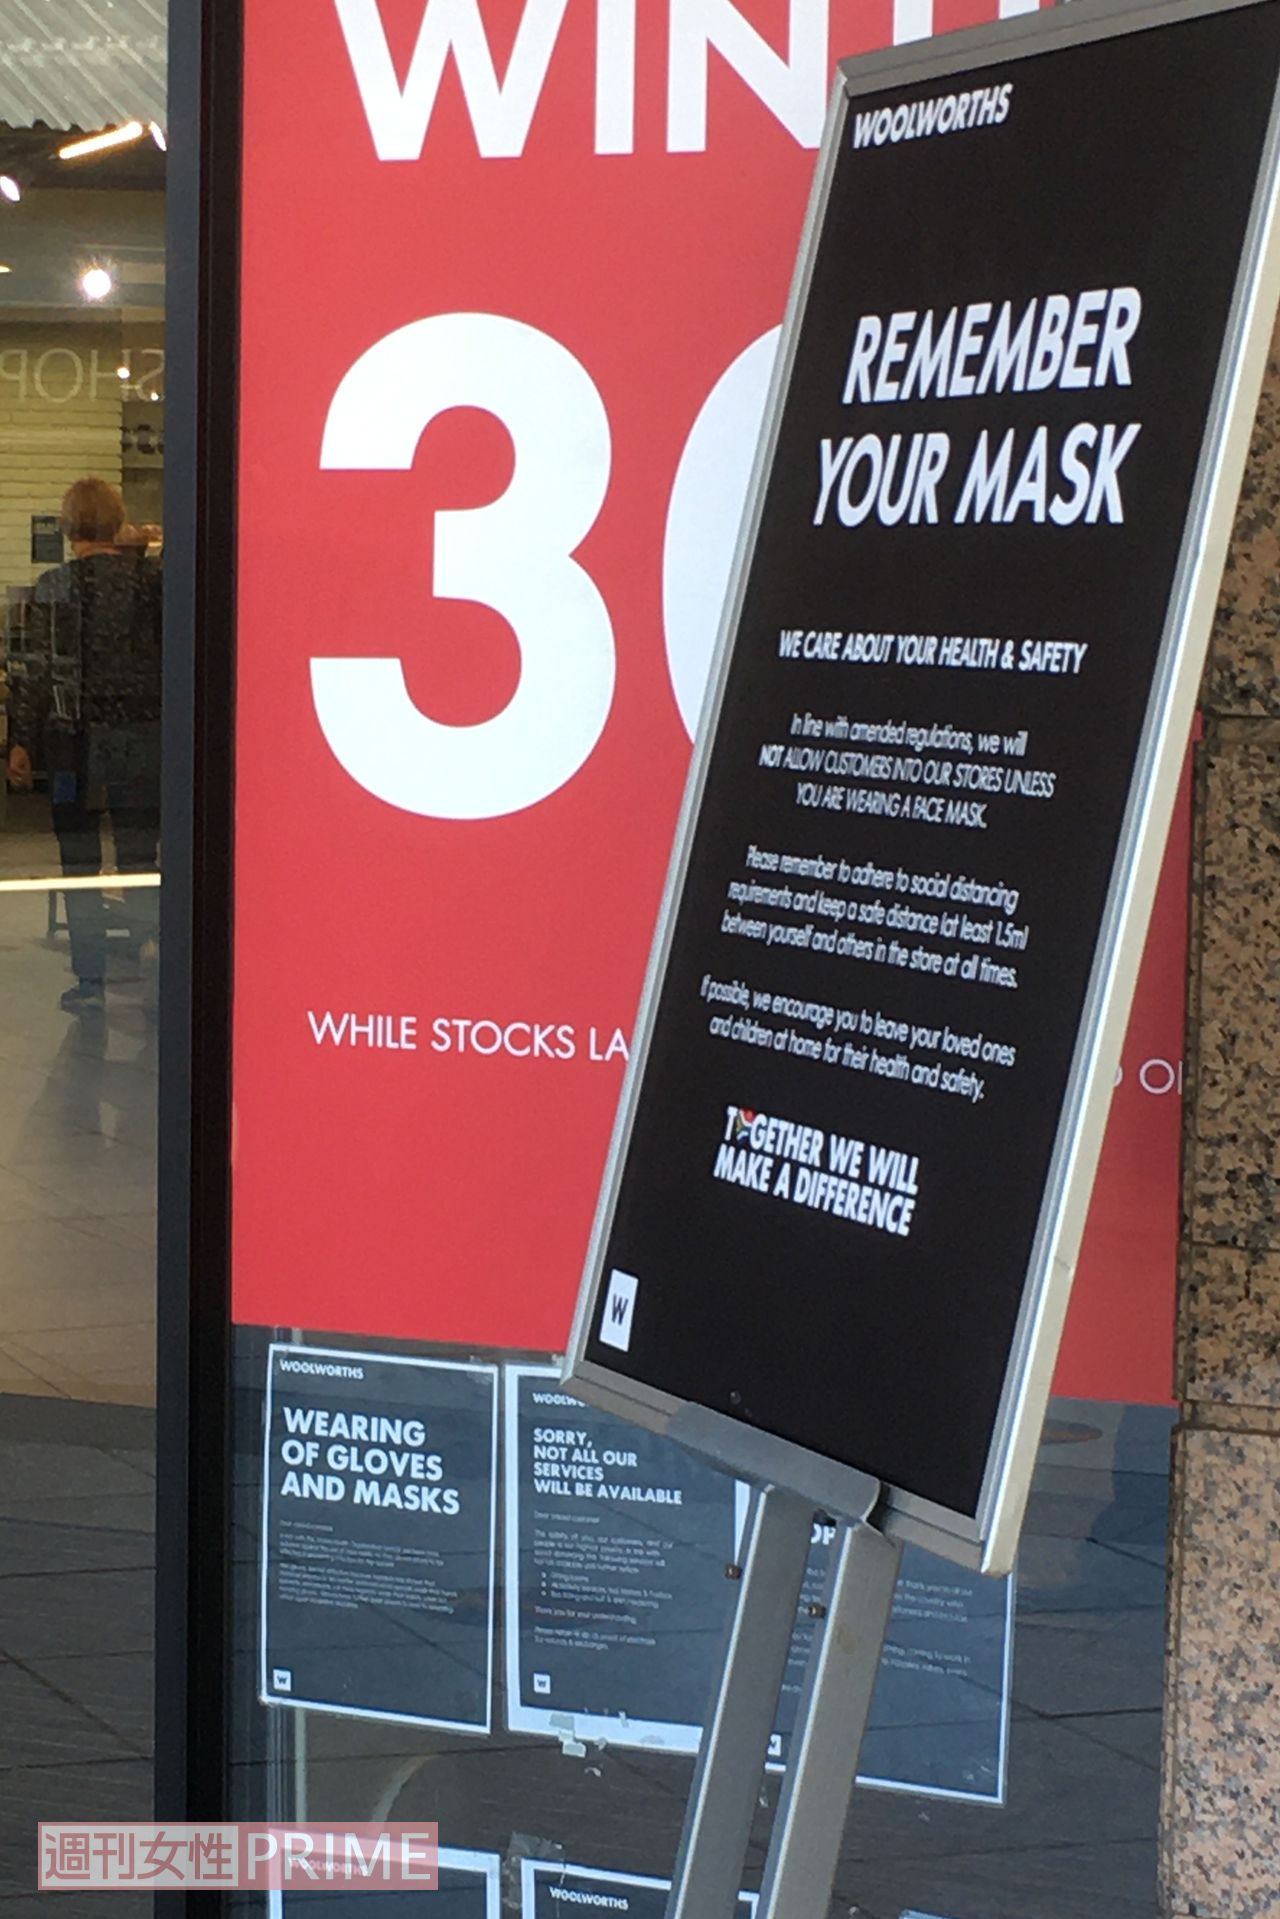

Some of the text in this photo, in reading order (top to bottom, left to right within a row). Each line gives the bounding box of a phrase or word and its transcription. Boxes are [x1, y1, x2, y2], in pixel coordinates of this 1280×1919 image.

[334, 0, 1041, 160] WIN
[854, 83, 1012, 148] WOOLWORTHS
[842, 287, 1142, 405] REMEMBER
[813, 423, 1142, 527] YOUR MASK
[779, 631, 1087, 673] WE CARE ABOUT YOUR HEALTH & SAFETY
[791, 713, 801, 734] In
[803, 713, 823, 736] line
[826, 716, 849, 738] with
[851, 720, 906, 743] amended
[978, 734, 999, 753] we
[1004, 731, 1027, 755] will
[759, 745, 784, 767] NOT
[784, 747, 824, 771] ALLOW
[825, 751, 892, 779] CUSTOMERS
[924, 760, 951, 785] OUR
[953, 763, 1003, 792] STORES
[1004, 768, 1056, 797] UNLESS
[796, 782, 822, 807] YOU
[822, 786, 845, 809] ARE
[847, 788, 901, 817] WEARING
[900, 794, 911, 818] A
[913, 796, 944, 822] FACE
[746, 845, 1019, 915] Please remember to adhere to social distancing
[793, 890, 819, 913] and
[818, 892, 845, 922] keep
[847, 901, 858, 921] a
[859, 900, 885, 925] safe
[886, 903, 938, 933] distance
[960, 914, 993, 943] least
[722, 909, 766, 938] between
[767, 924, 814, 947] yourself
[812, 929, 839, 952] and
[837, 932, 873, 960] others
[875, 937, 886, 962] in
[888, 940, 908, 966] the
[910, 946, 942, 973] store
[944, 953, 960, 976] at
[962, 955, 979, 979] all
[701, 974, 711, 997] If
[753, 991, 770, 1011] we
[773, 996, 833, 1029] encourage
[834, 1009, 858, 1032] you
[860, 1010, 872, 1034] to
[874, 1012, 908, 1041] leave
[910, 1026, 942, 1049] your
[942, 1026, 982, 1058] loved
[982, 1042, 1016, 1066] ones
[308, 1011, 416, 1049] WHILE
[432, 1019, 575, 1058] STOCKS
[1139, 1058, 1183, 1095] O
[710, 1015, 733, 1037] and
[732, 1017, 772, 1047] children
[774, 1029, 788, 1050] at
[789, 1030, 822, 1059] home
[824, 1037, 841, 1063] for
[843, 1043, 868, 1069] their
[870, 1049, 909, 1079] health
[912, 1063, 941, 1087] and
[714, 1144, 915, 1236] MAKE A DIFFERENCE
[830, 1134, 864, 1177] WE
[869, 1146, 919, 1195] WILL
[281, 1361, 363, 1379] WOOLWORTHS
[284, 1408, 425, 1446] WEARING
[534, 1429, 592, 1447] SORRY,
[282, 1440, 443, 1481] OF GLOVES
[533, 1445, 638, 1467] NOT ALL OUR
[534, 1463, 603, 1480] SERVICES
[281, 1472, 459, 1514] AND MASKS
[533, 1479, 682, 1504] WILL BE AVAILABLE
[550, 1887, 628, 1909] WOOLWORTHS
